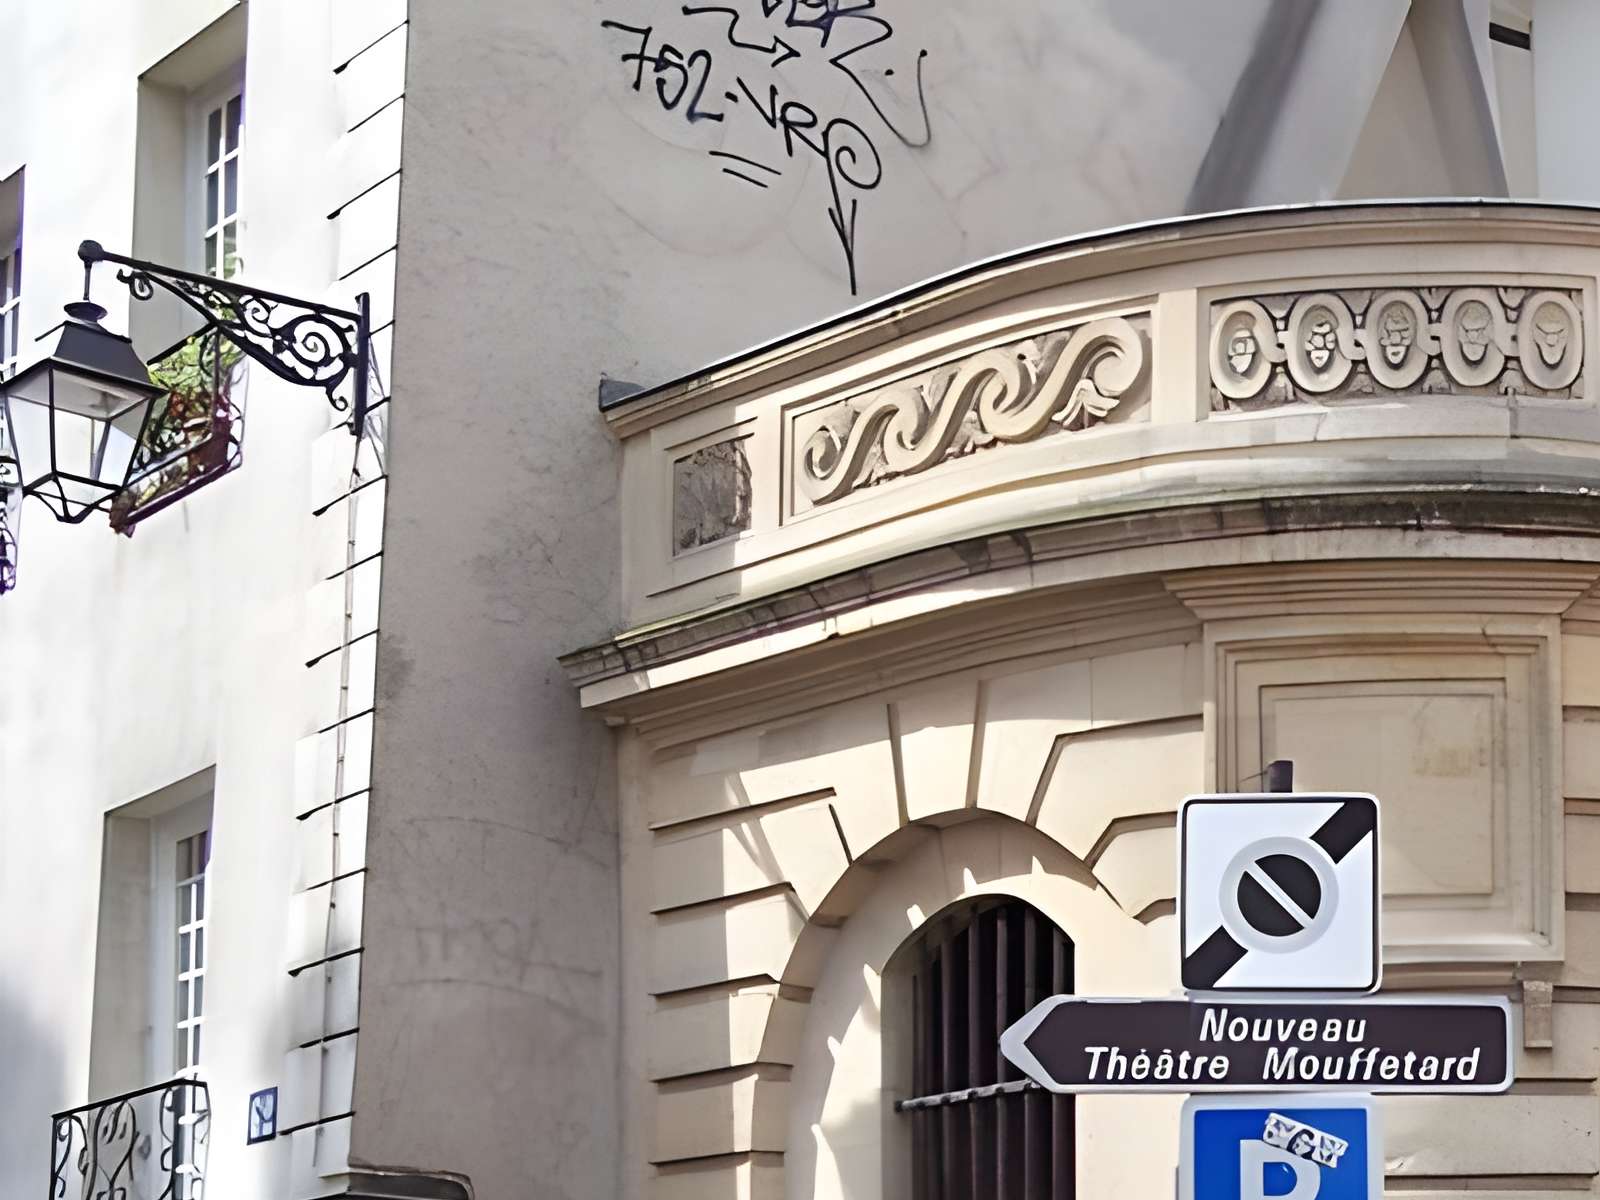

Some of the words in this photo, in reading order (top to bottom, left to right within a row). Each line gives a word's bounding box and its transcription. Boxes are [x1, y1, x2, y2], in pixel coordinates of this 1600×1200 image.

[1199, 1007, 1367, 1043] Nouveau
[1083, 1045, 1231, 1081] Théâtre
[1263, 1047, 1482, 1082] Mouffetard
